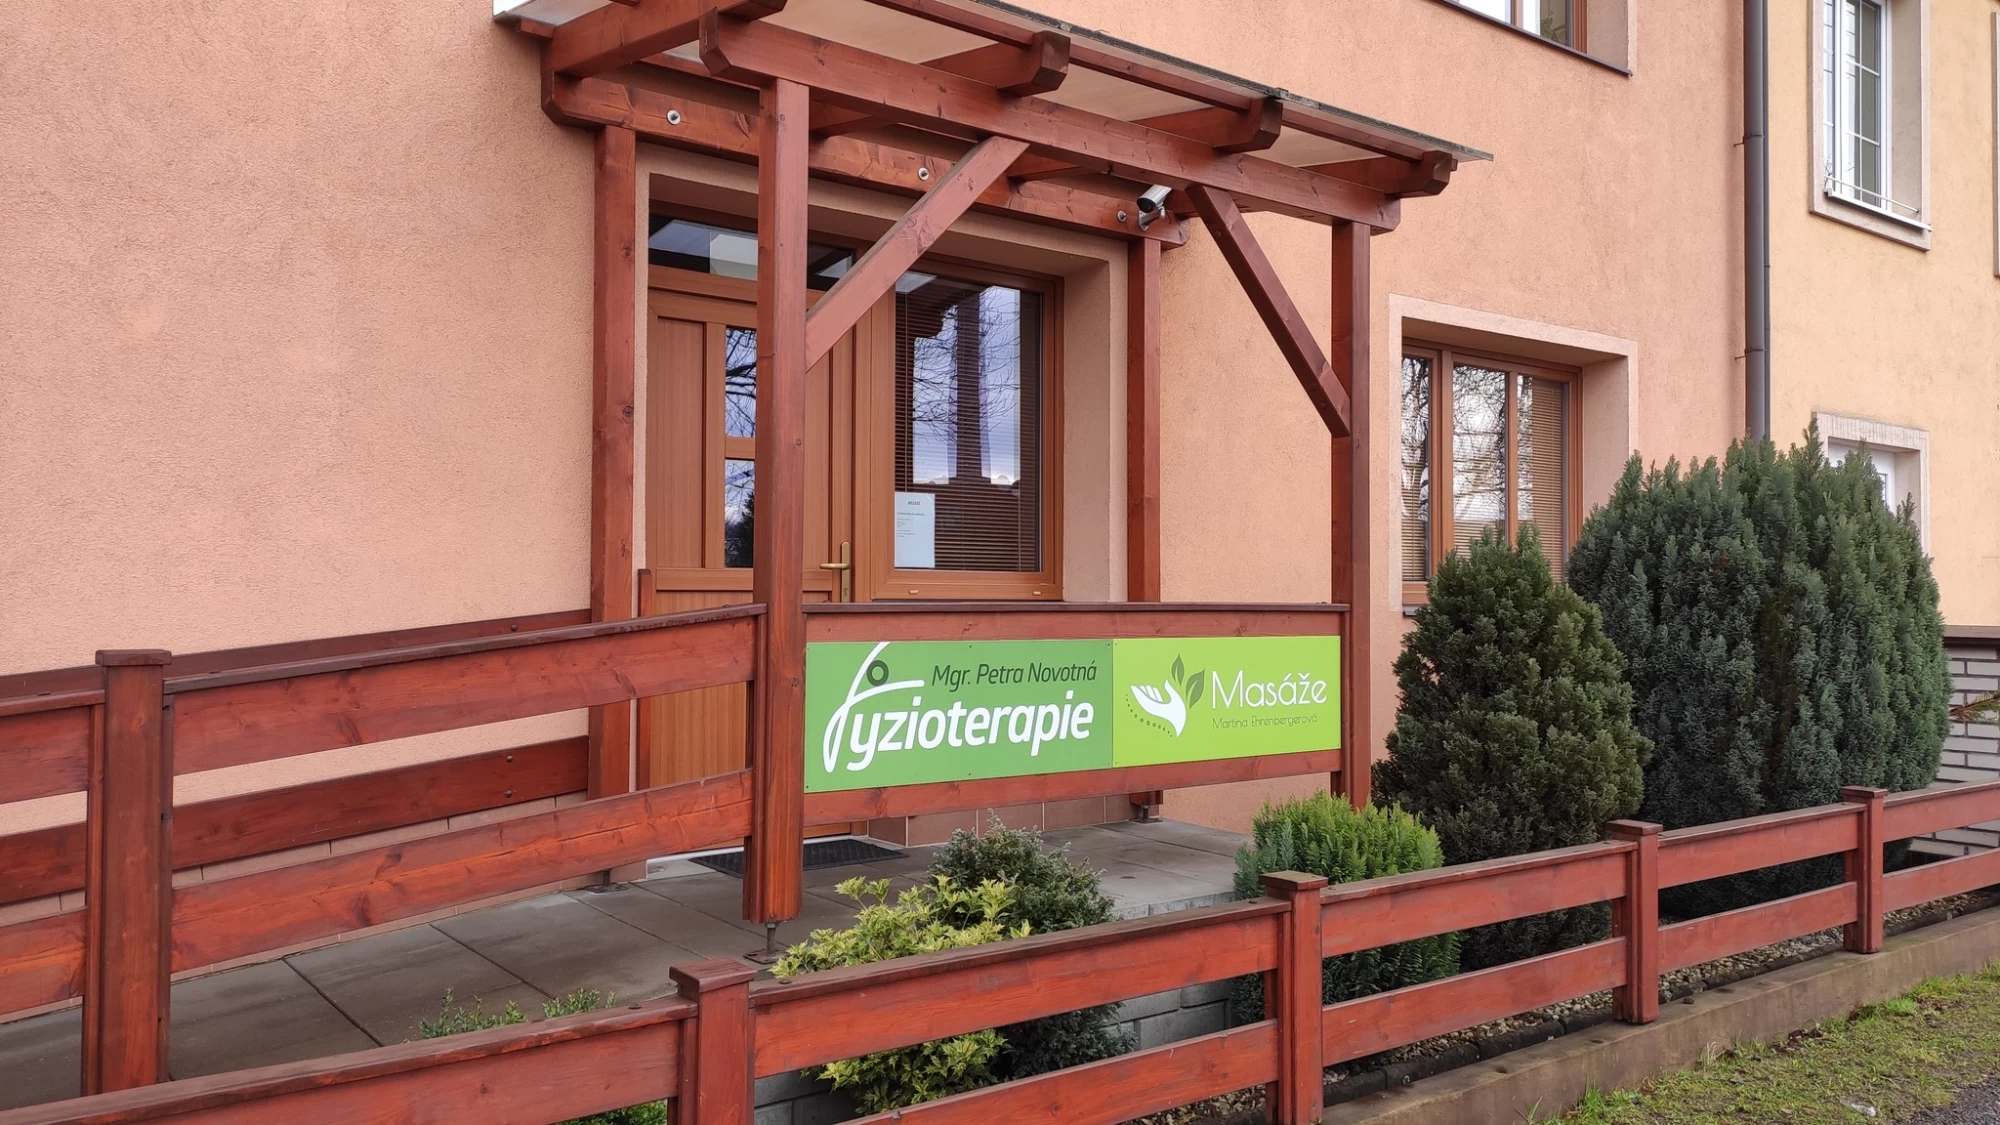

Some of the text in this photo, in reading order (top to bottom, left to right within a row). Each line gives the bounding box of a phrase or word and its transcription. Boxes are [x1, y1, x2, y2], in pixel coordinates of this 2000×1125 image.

[931, 660, 1098, 693] Mgr. Petra Novotná
[1212, 669, 1327, 710] Masáže
[1212, 713, 1318, 730] Martina Ehrenbergerová
